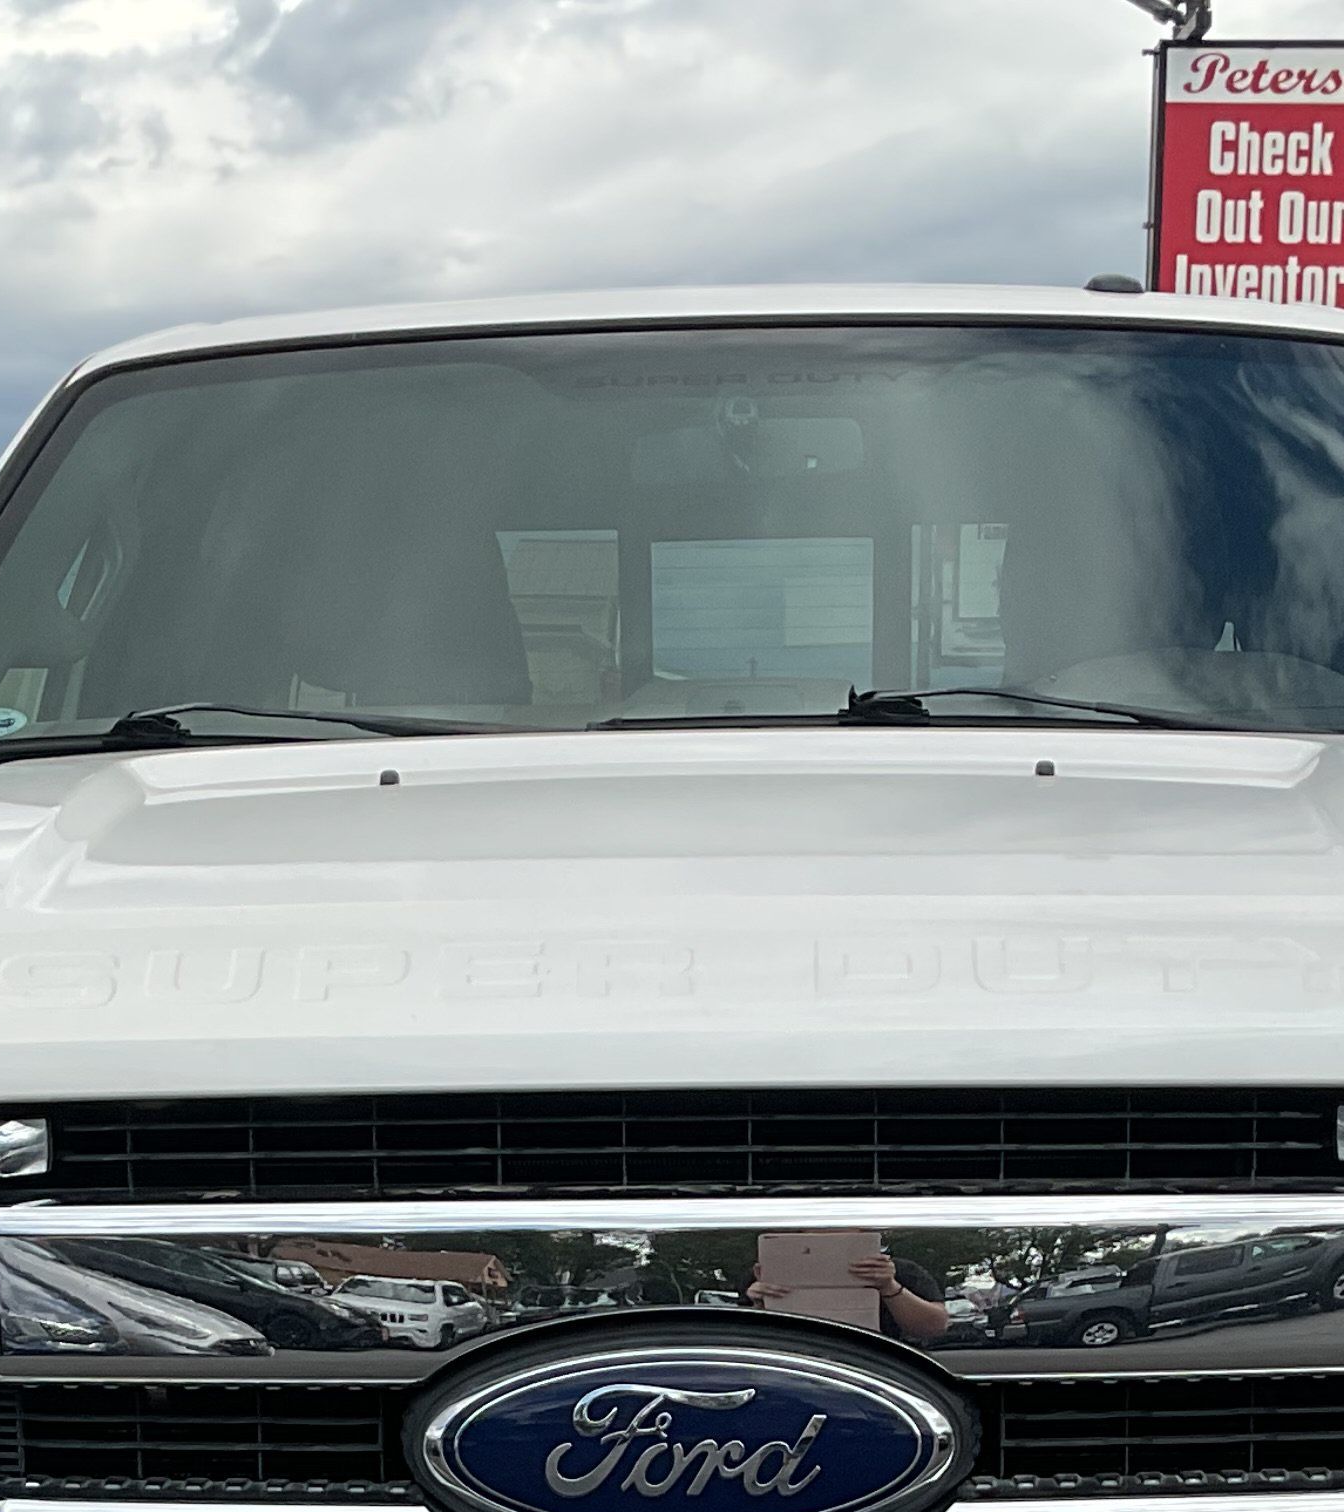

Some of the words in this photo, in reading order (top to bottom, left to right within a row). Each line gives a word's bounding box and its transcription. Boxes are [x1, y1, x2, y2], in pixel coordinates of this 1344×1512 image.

[1208, 120, 1335, 177] Check
[1194, 188, 1264, 245] Out
[545, 1384, 828, 1497] Ford
